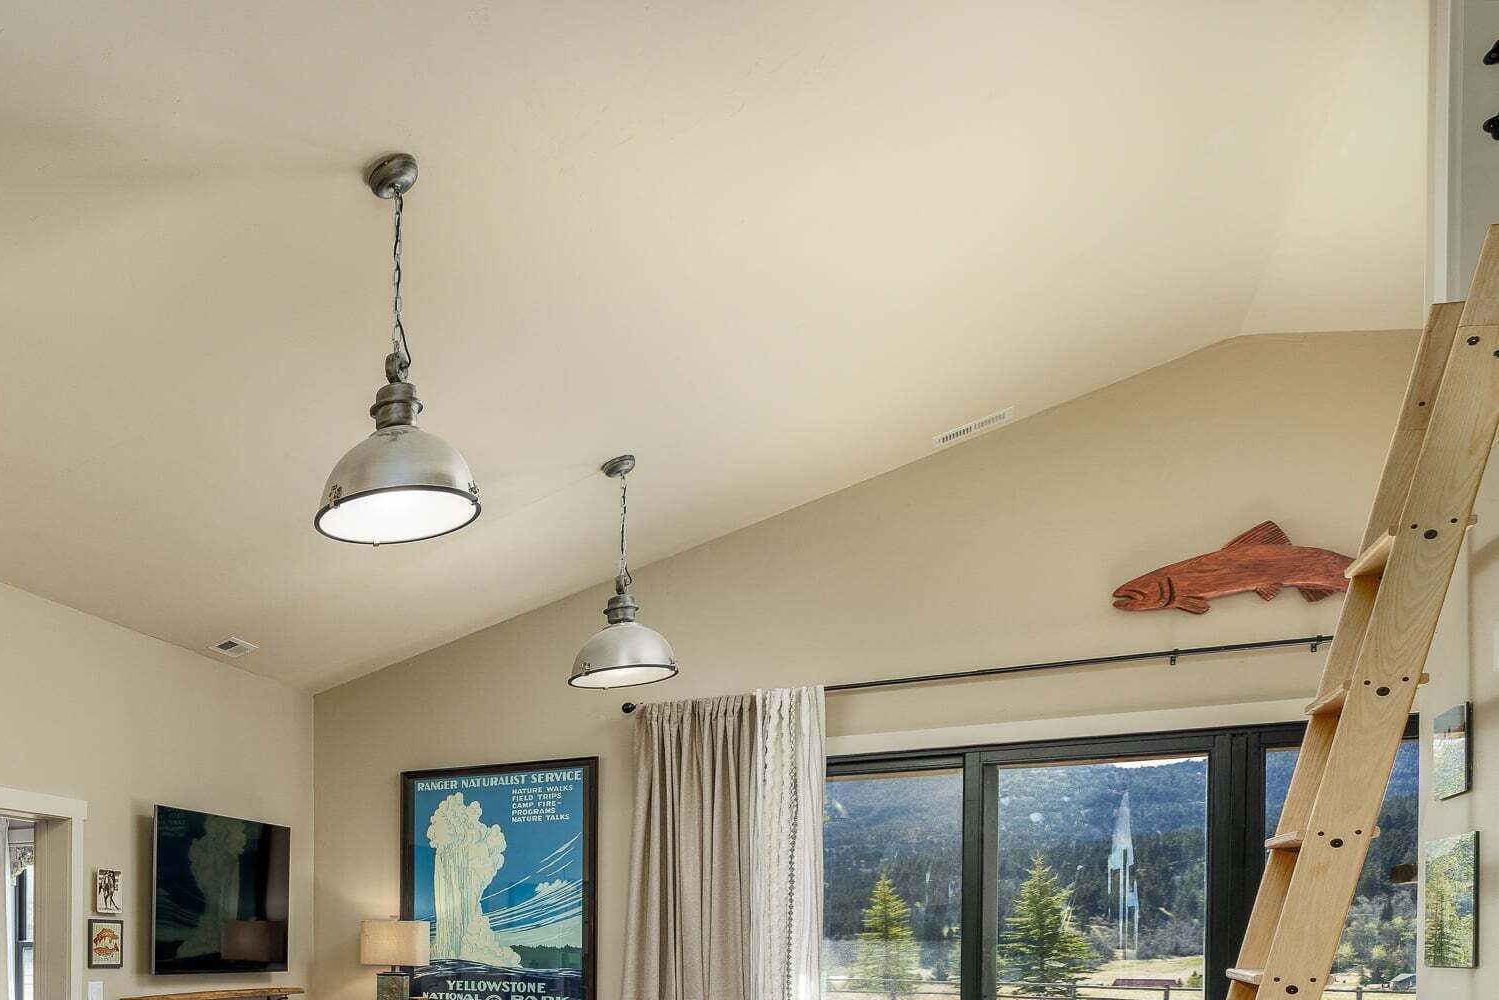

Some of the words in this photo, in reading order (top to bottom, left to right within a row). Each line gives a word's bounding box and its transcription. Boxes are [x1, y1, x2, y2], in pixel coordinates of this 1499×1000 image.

[417, 781, 458, 791] RANGER
[461, 774, 527, 789] NATURALIST
[531, 770, 582, 784] SERVICE
[512, 787, 543, 795] NATURE
[546, 785, 573, 793] WALKS
[537, 792, 562, 800] TRIPS
[512, 807, 556, 816] PROGRAMS
[512, 815, 543, 823] NATURE
[446, 980, 546, 994] YELLOWSTONE
